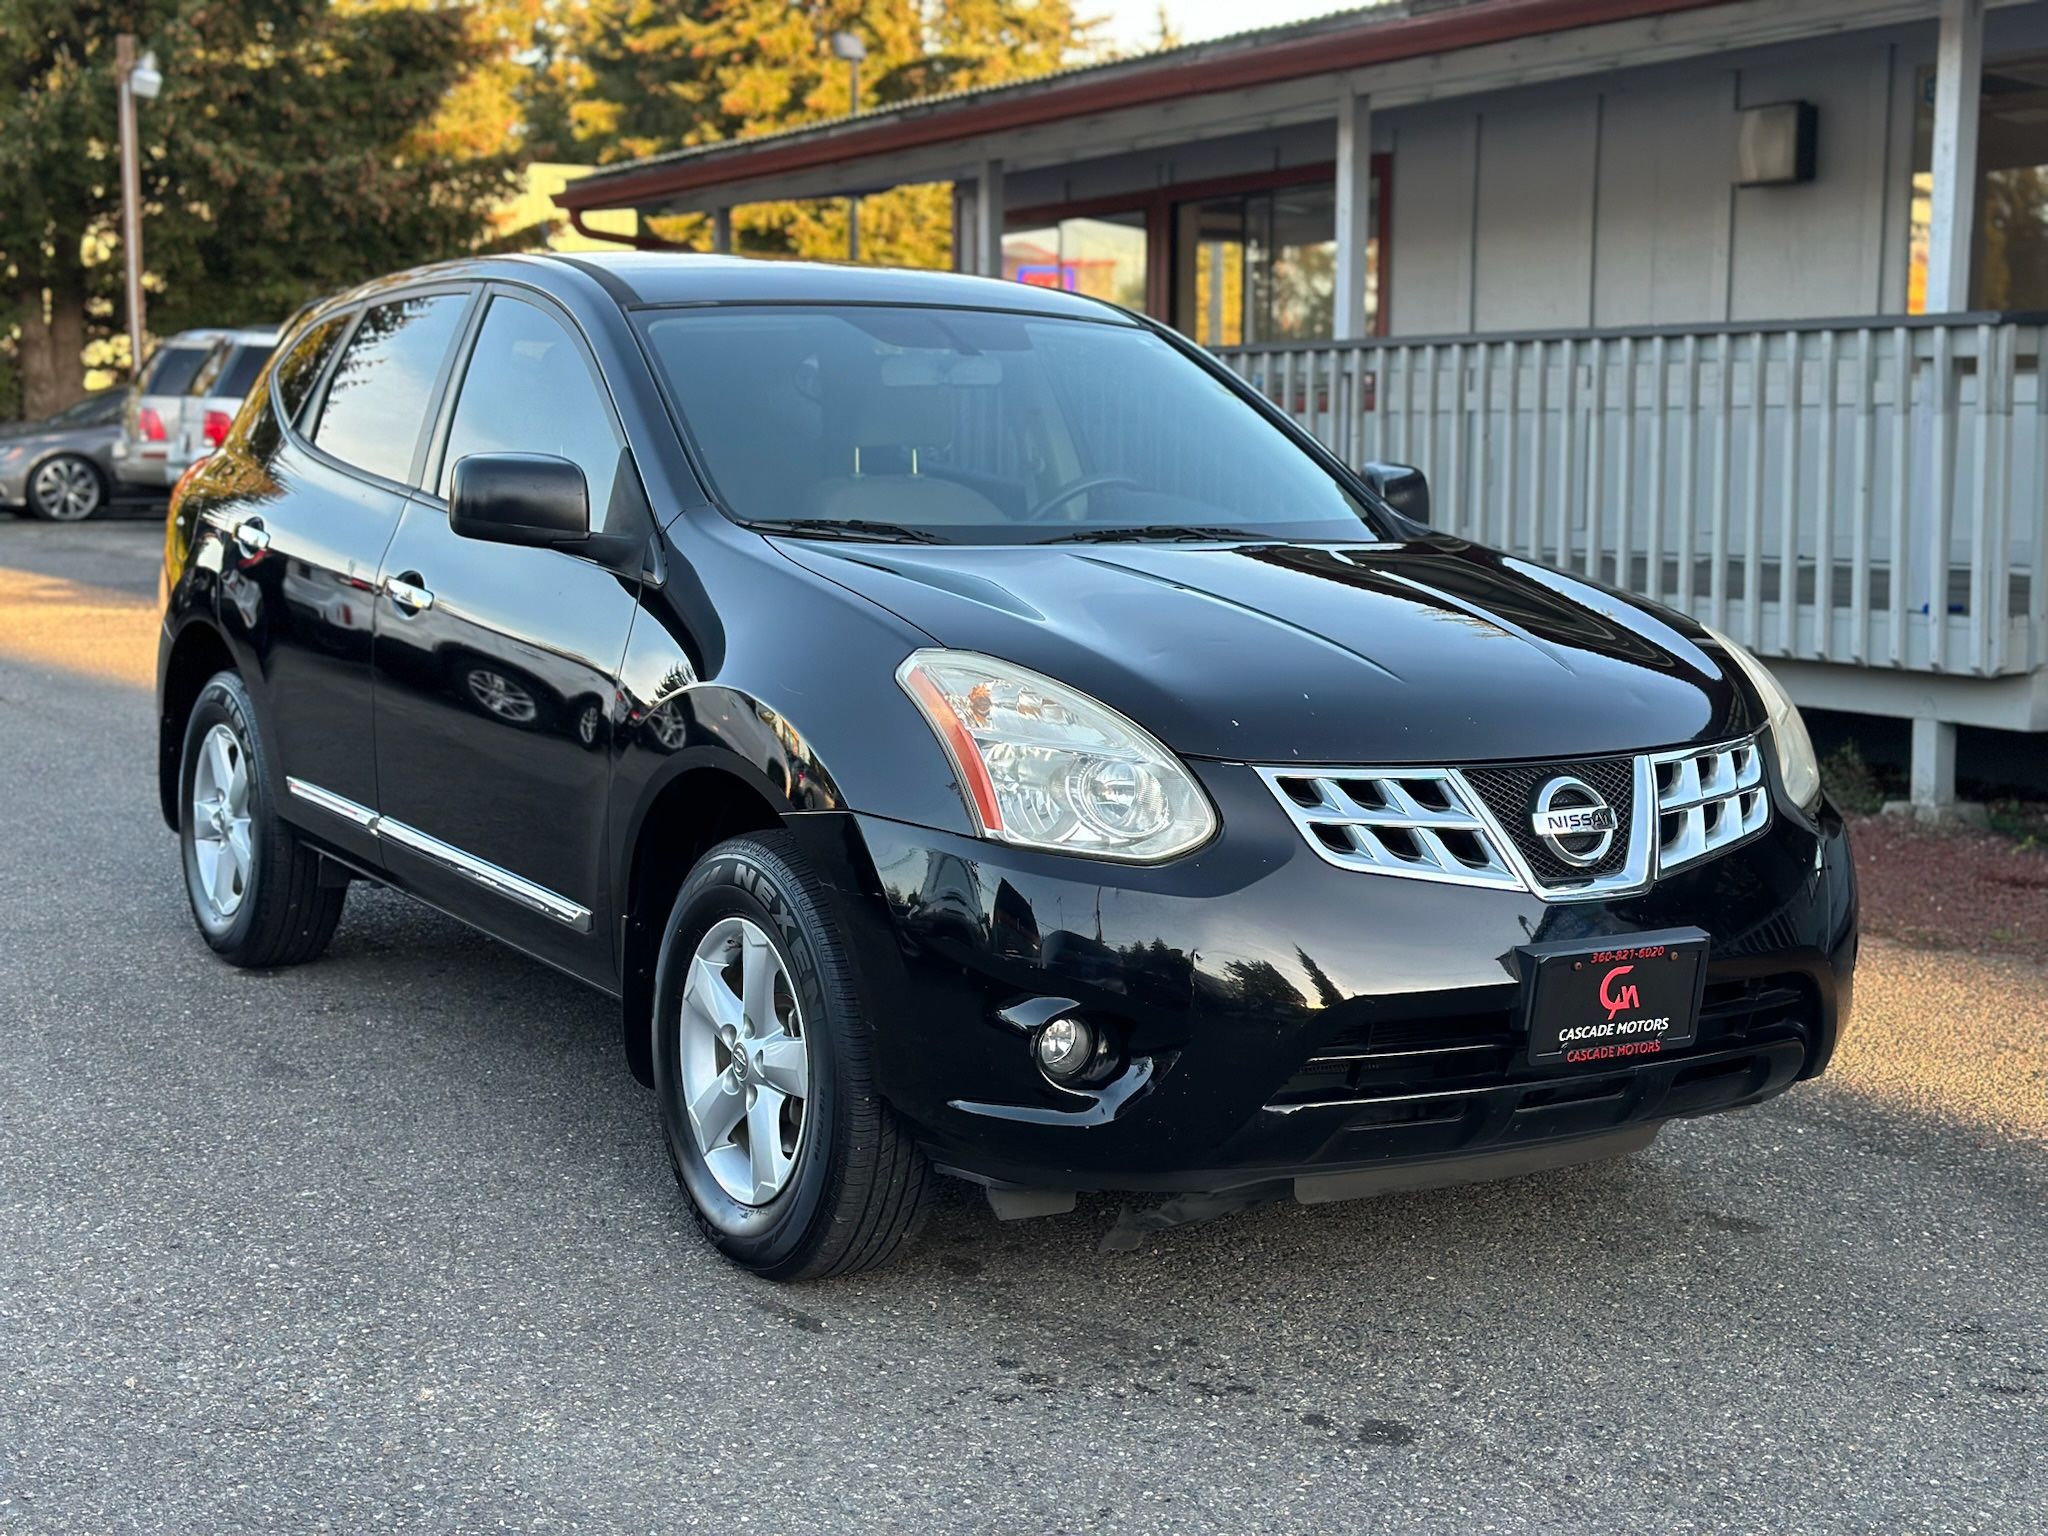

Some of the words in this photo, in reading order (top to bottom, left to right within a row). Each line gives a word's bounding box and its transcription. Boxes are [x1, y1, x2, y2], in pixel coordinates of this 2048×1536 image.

[1547, 811, 1615, 829] NISSAN
[1590, 946, 1665, 963] 360-821-6020
[1559, 1023, 1615, 1042] CASCADE
[1616, 1017, 1669, 1035] MOTORS
[1567, 1045, 1614, 1063] CASCADE
[1616, 1039, 1661, 1056] MOTORS
